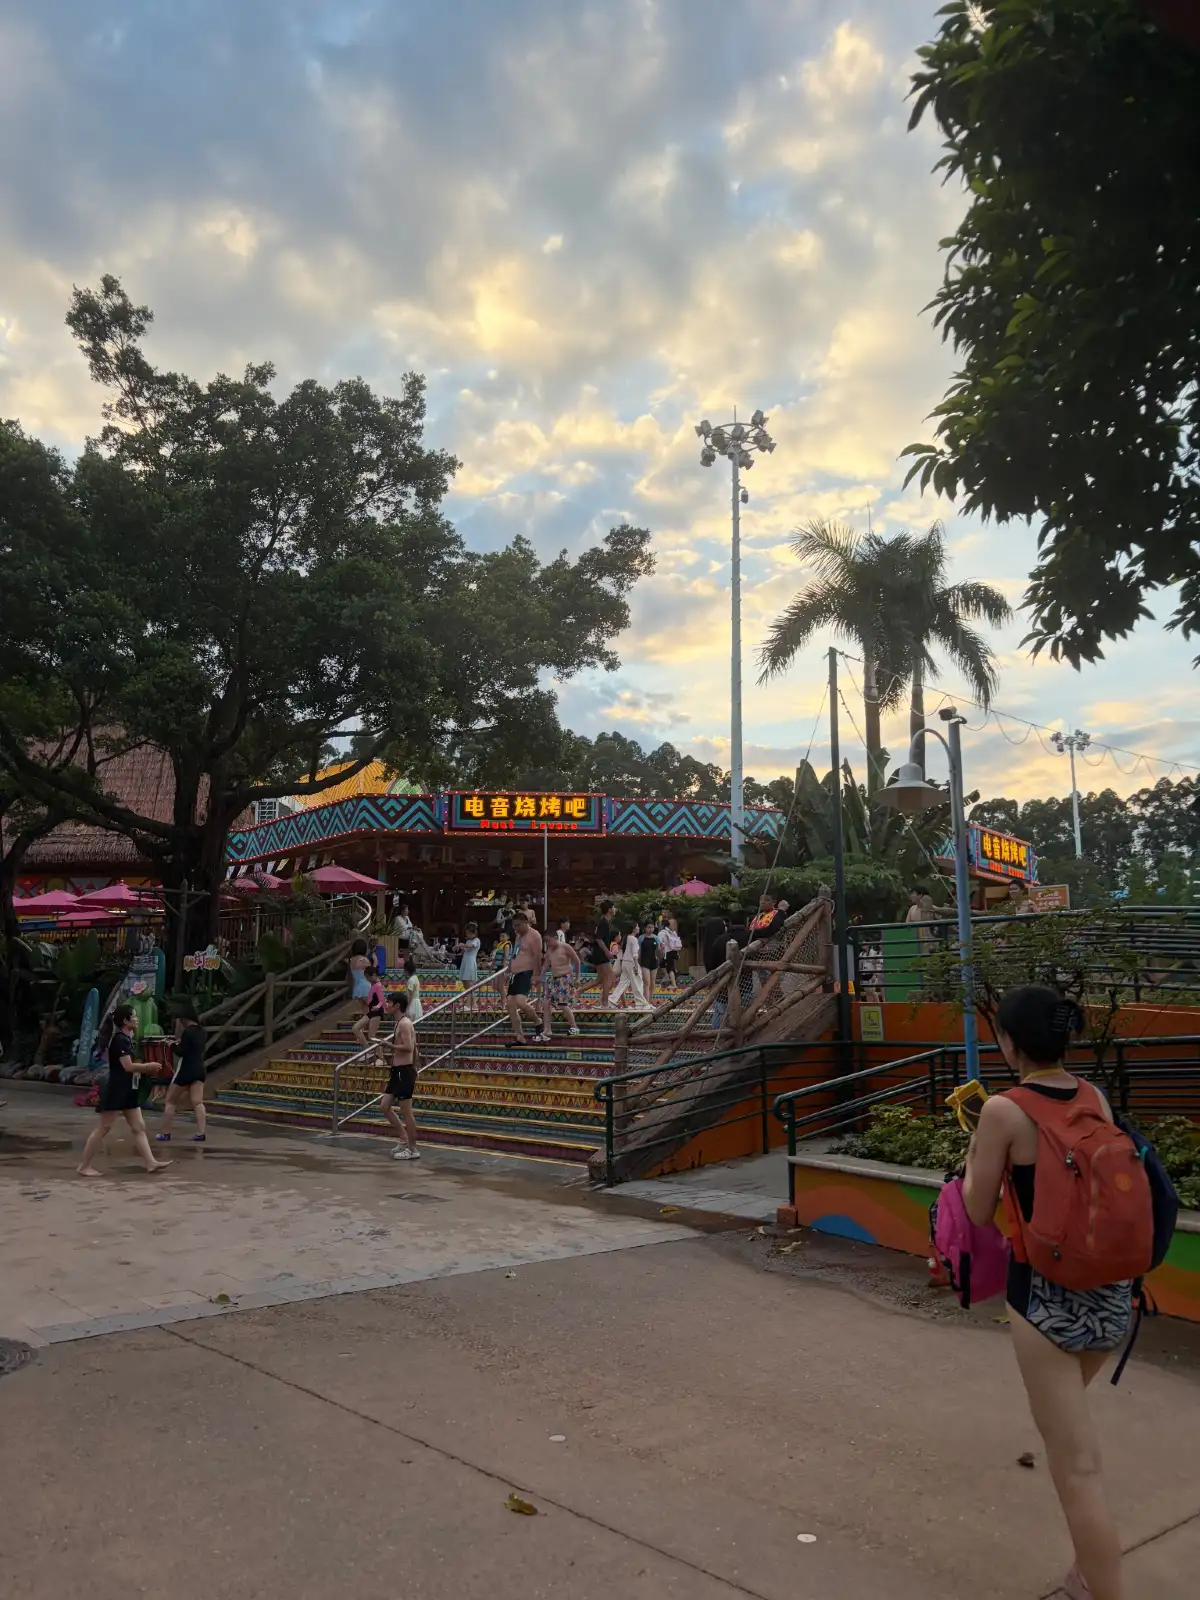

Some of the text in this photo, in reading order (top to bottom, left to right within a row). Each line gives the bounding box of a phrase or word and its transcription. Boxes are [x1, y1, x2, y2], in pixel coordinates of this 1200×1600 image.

[465, 796, 586, 817] 电音烧烤吧
[983, 832, 1027, 866] 电音烧烤吧
